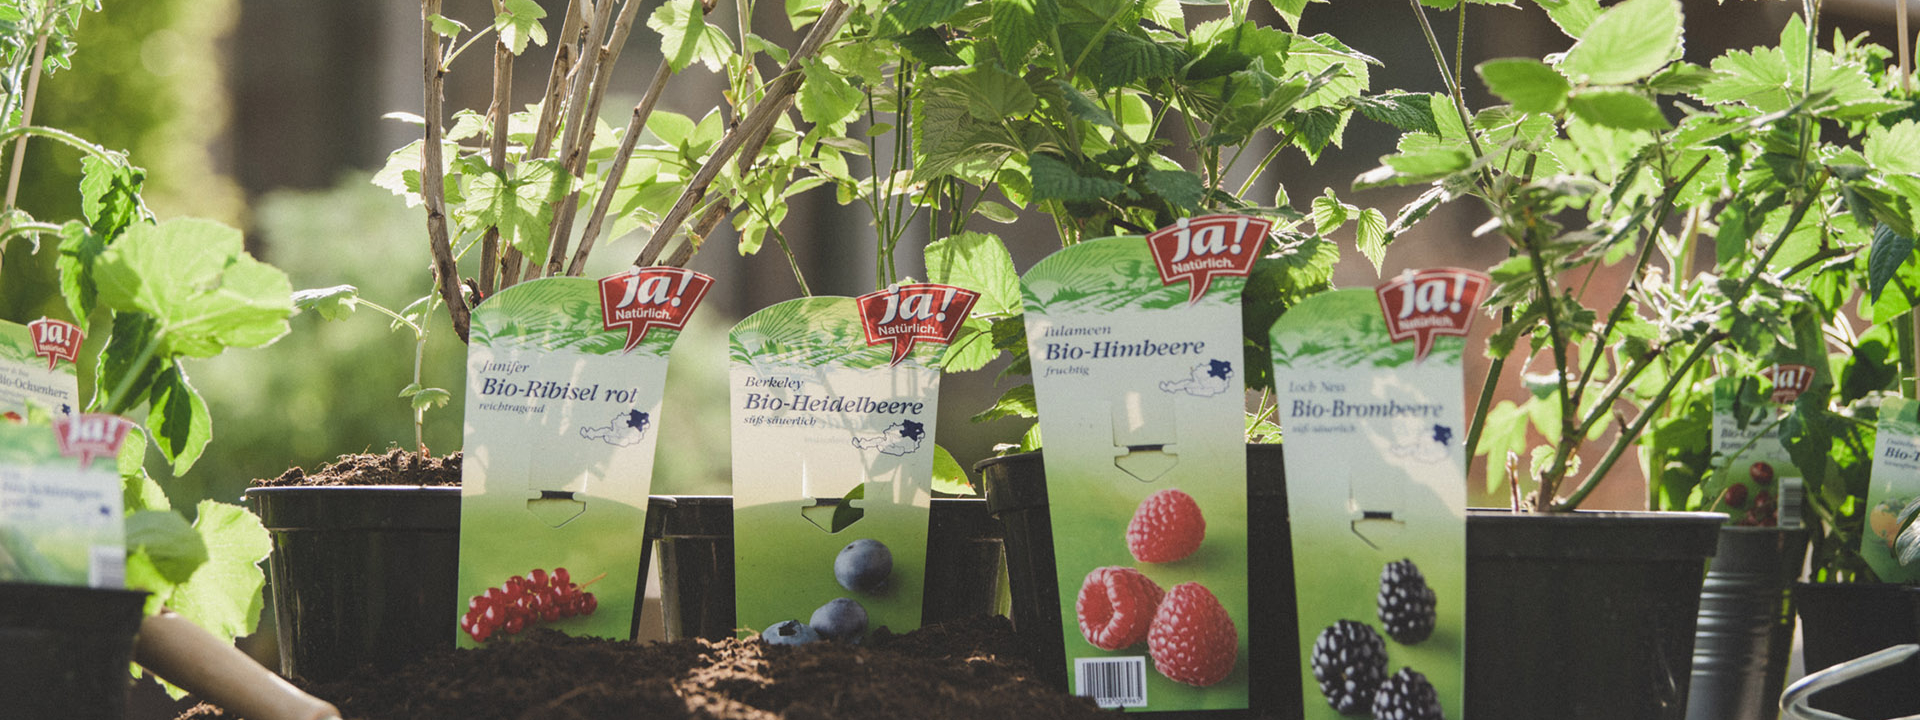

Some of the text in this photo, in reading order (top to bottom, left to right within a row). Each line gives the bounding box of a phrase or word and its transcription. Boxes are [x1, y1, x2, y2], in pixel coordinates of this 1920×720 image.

[1172, 217, 1249, 263] ja!
[1171, 257, 1235, 274] Natürlich.
[616, 265, 694, 308] ja!
[1398, 268, 1467, 319] ja!
[615, 307, 672, 320] Natürlich.
[878, 284, 957, 325] ja!
[39, 316, 73, 347] ja!
[877, 323, 938, 336] Natürlich.
[1043, 325, 1112, 338] Tulameen
[1045, 339, 1205, 361] Bio-Himbeere
[479, 360, 530, 375] Junifer
[1044, 365, 1090, 378] fruchtig
[481, 377, 638, 404] Bio-Ribisel rot
[745, 376, 804, 391] Berkeley
[479, 401, 545, 414] reichtragend
[744, 393, 923, 414] Bio-Heidelbeere
[1291, 399, 1444, 418] Bio-Brombeere
